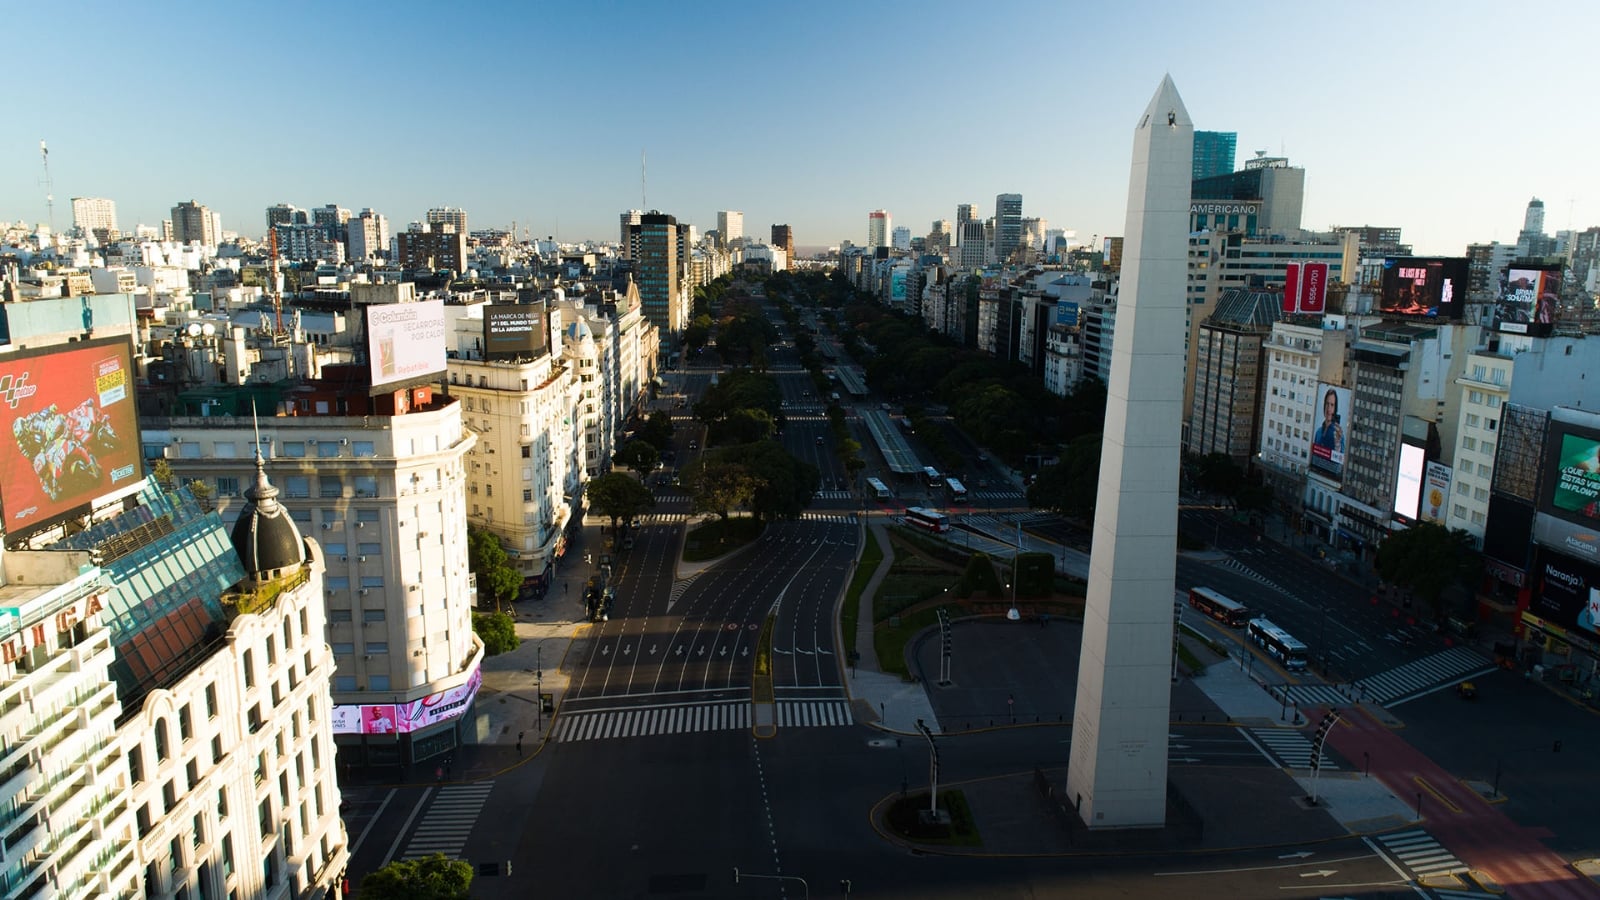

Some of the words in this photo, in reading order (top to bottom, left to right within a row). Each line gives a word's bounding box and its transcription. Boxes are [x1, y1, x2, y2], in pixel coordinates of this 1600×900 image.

[1190, 204, 1256, 214] AMERICANO
[379, 308, 417, 324] Columbia
[1560, 481, 1572, 490] EN
[1571, 484, 1598, 498] FLOW?
[1565, 535, 1597, 553] Atacama
[1545, 563, 1579, 586] Naranja
